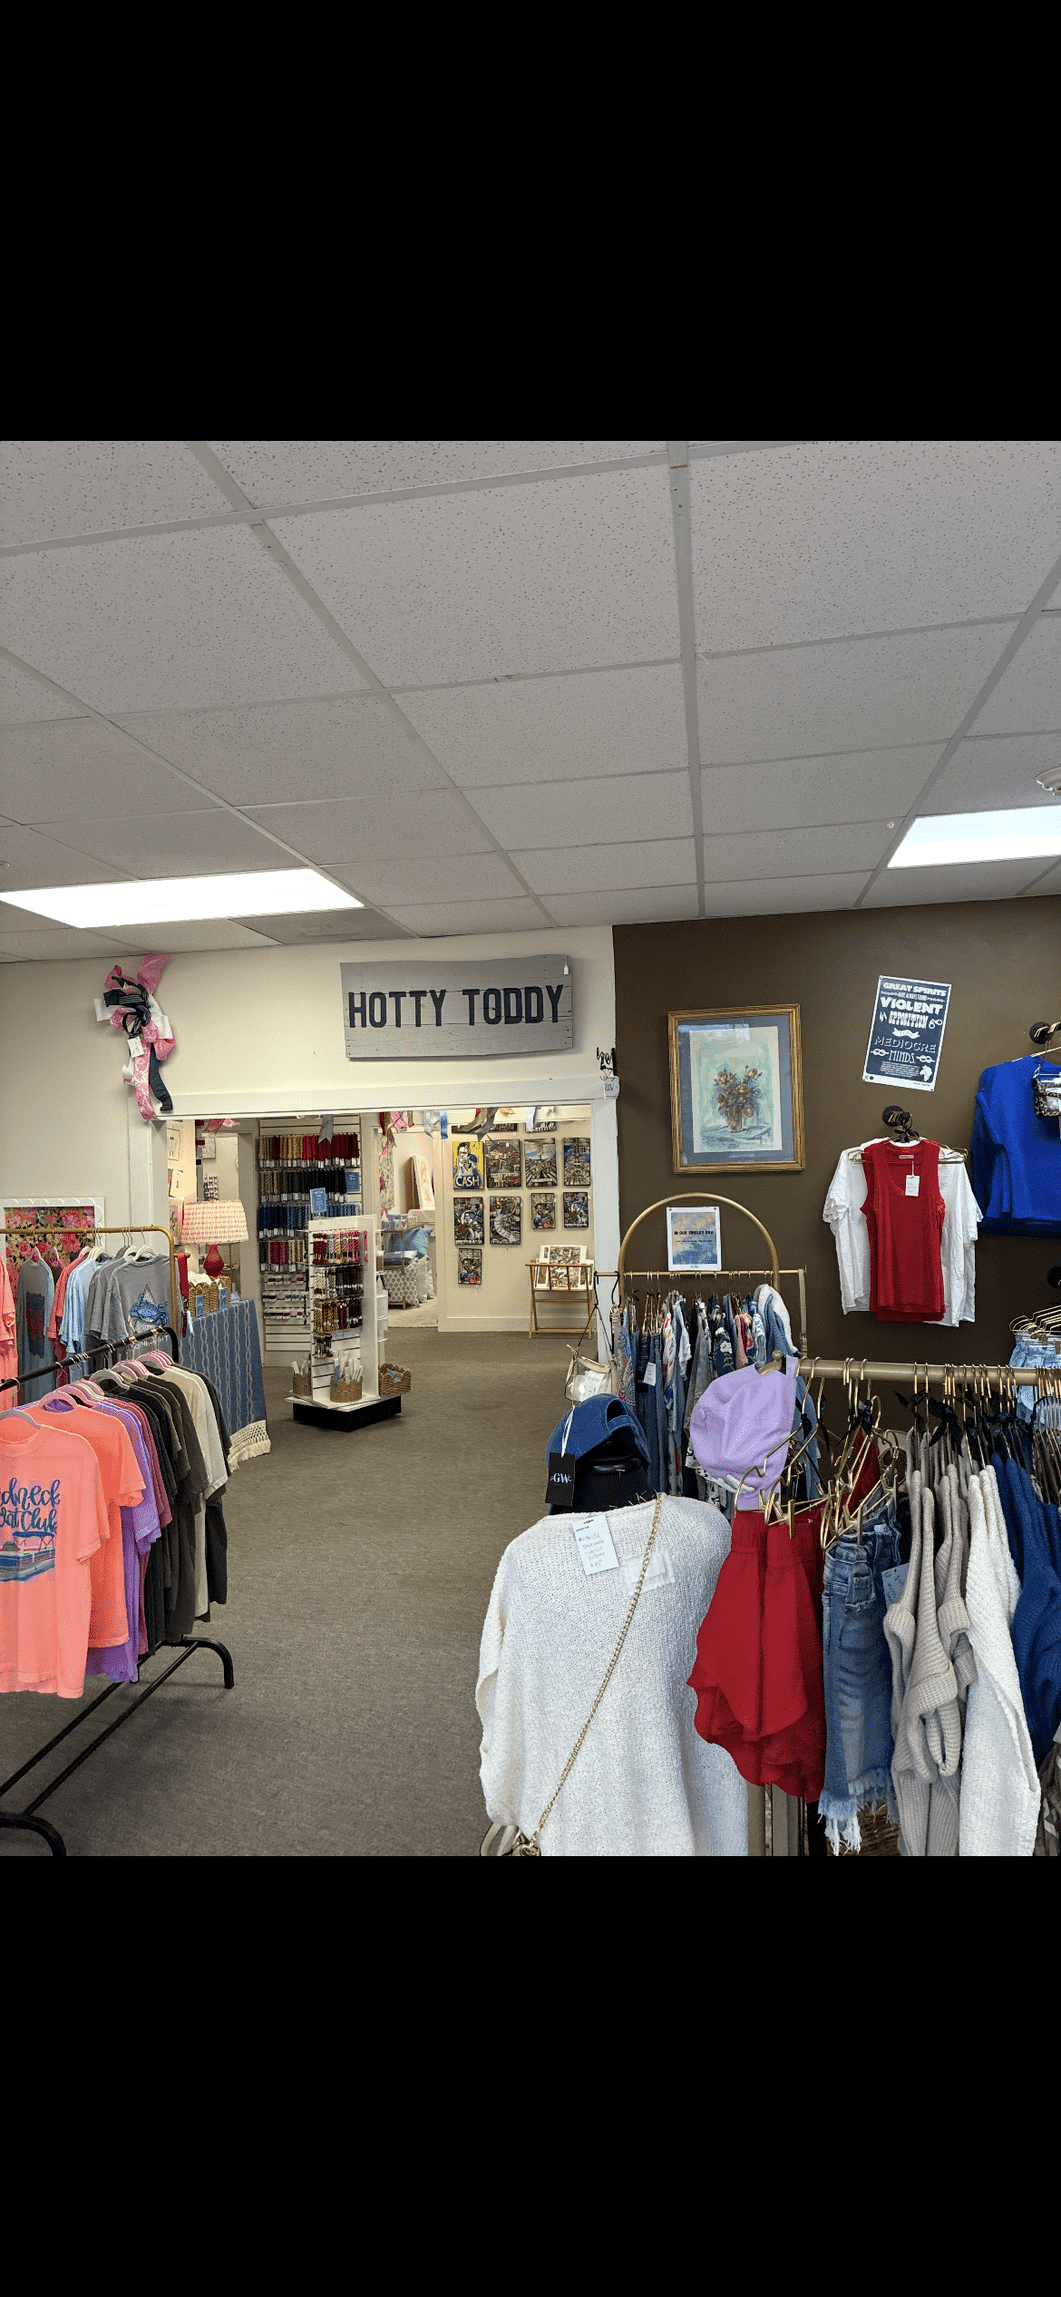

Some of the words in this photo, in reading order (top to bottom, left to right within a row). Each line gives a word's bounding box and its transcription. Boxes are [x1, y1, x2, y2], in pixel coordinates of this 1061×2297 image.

[882, 982, 912, 992] GREAT
[913, 985, 947, 997] SPIRITS
[348, 989, 447, 1029] HOTTY
[462, 984, 564, 1026] TODDY
[880, 996, 943, 1015] VIOLENT
[874, 1036, 937, 1054] MEDIOCRE
[456, 1176, 480, 1187] CASH
[21, 1507, 58, 1534] Club
